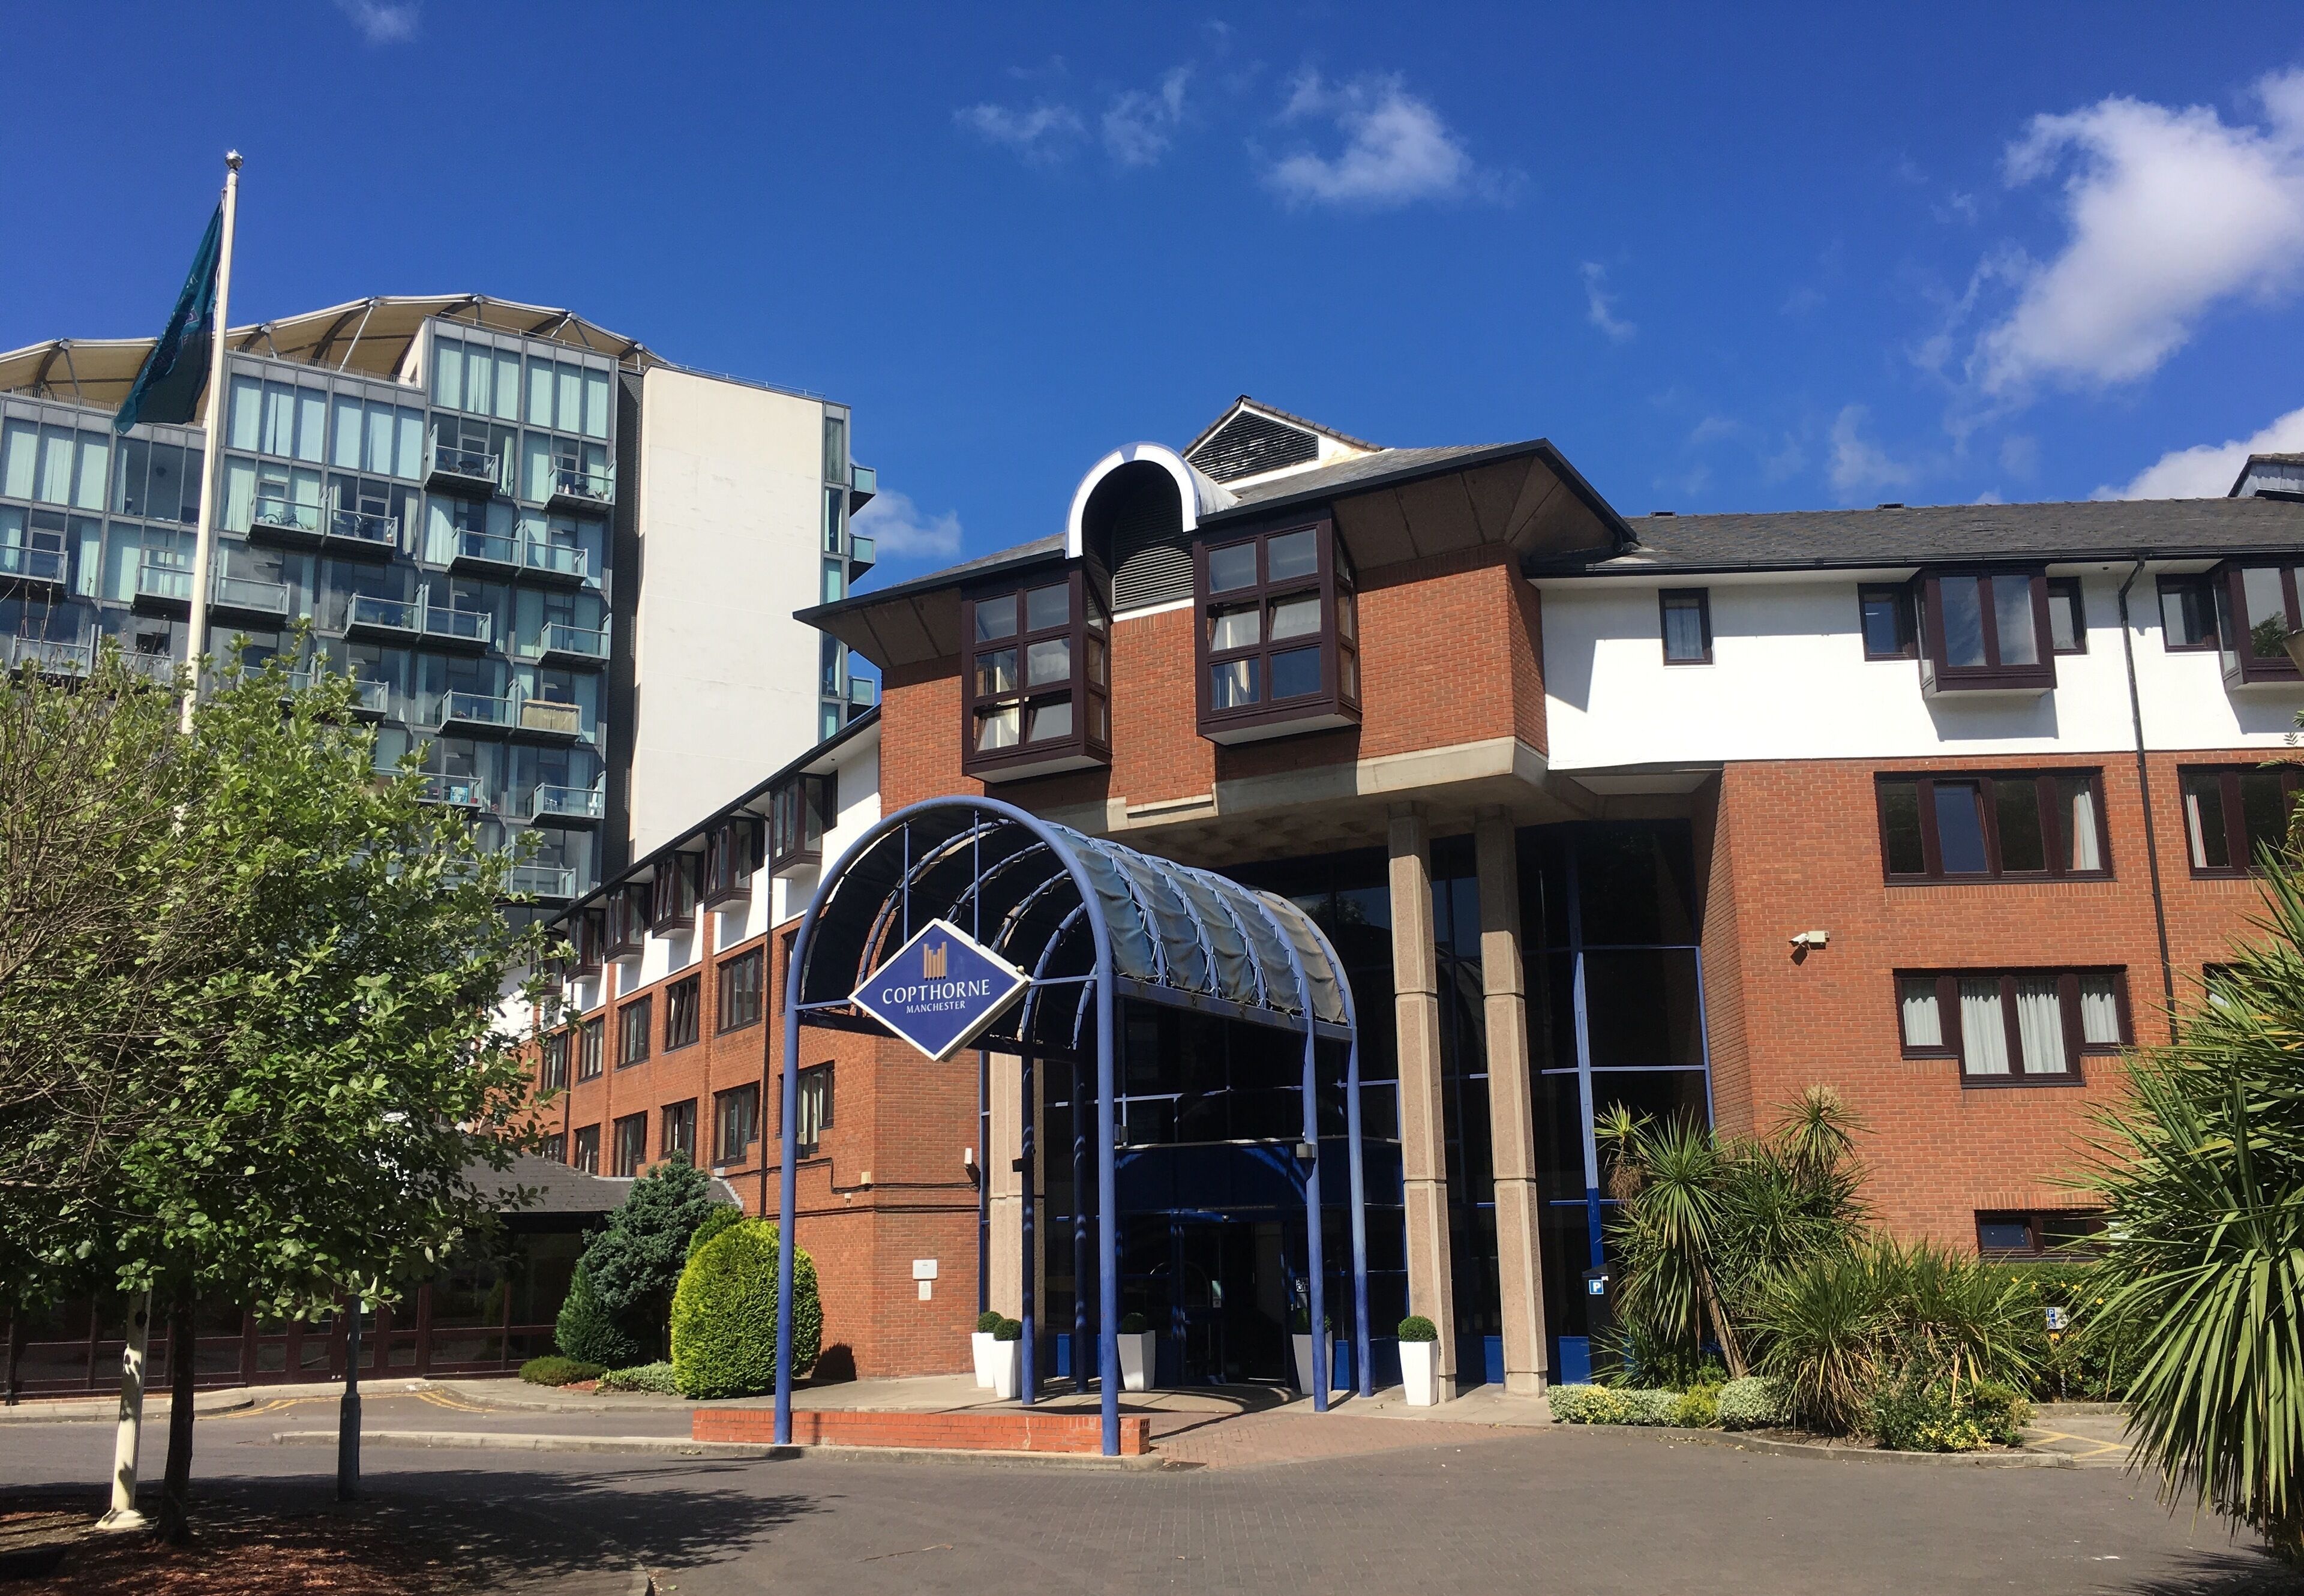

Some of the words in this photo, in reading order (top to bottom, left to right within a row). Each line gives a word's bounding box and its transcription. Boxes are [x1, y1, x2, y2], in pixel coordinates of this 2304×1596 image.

[883, 979, 990, 1004] COPTHORNE
[906, 1000, 965, 1013] MANCHESTER
[1593, 1282, 1601, 1292] P
